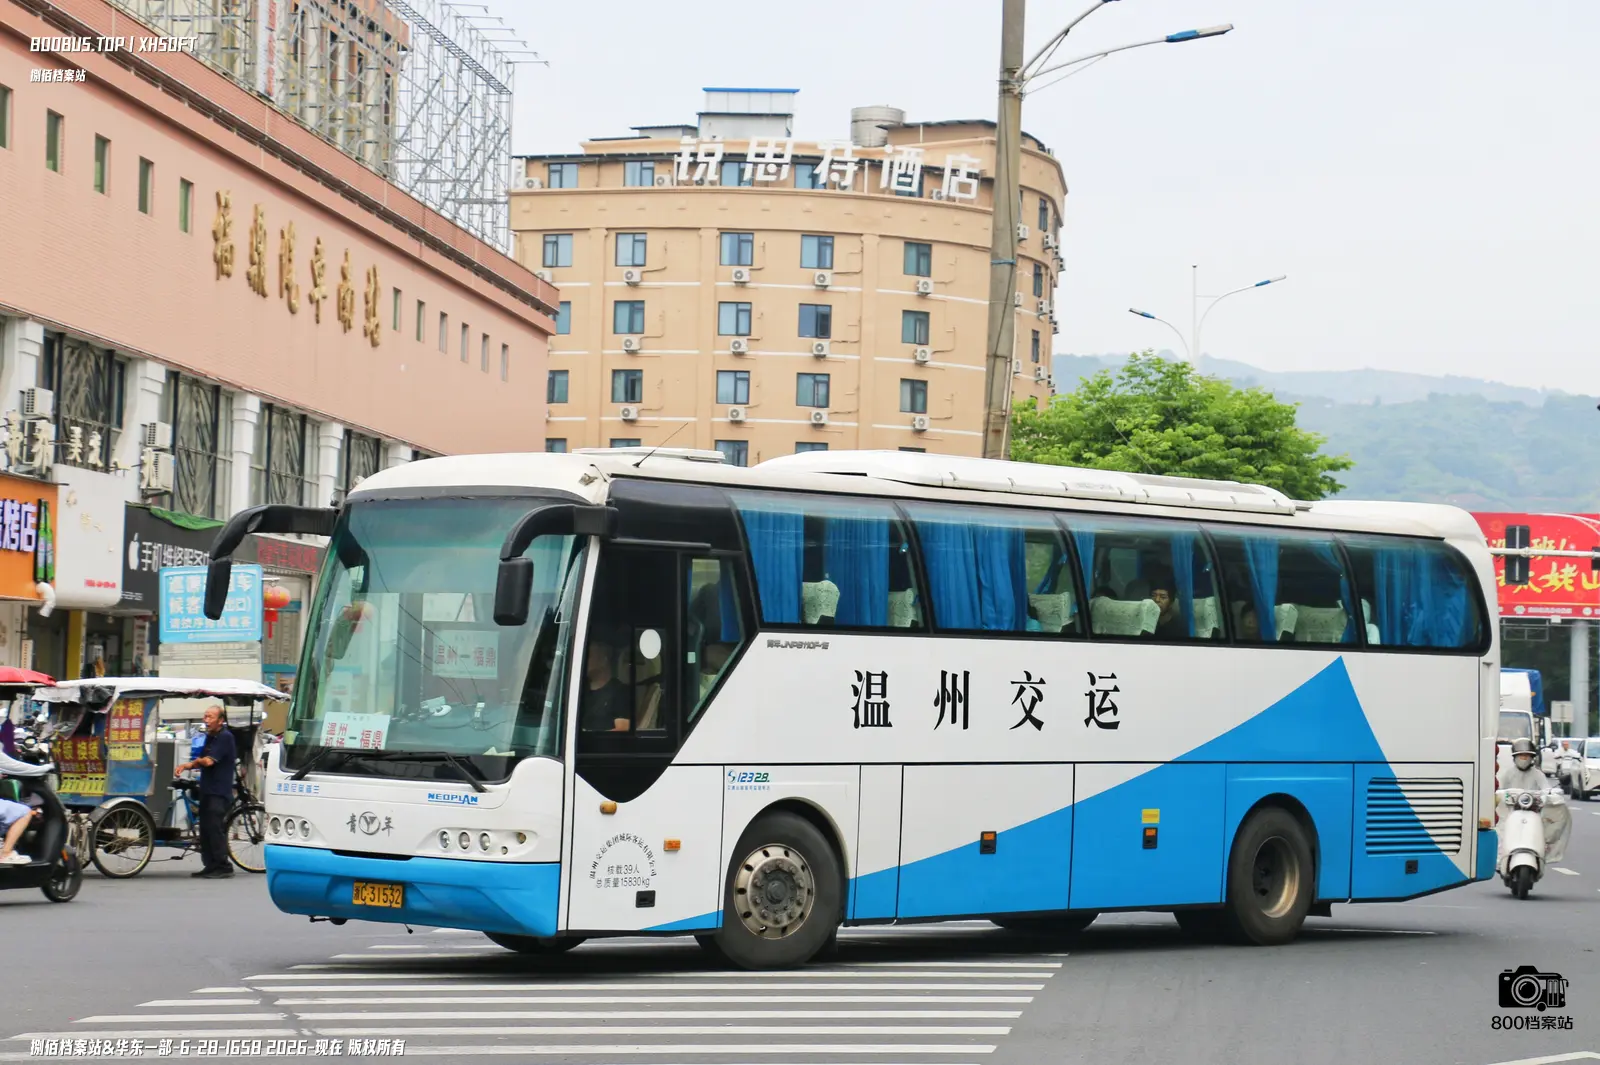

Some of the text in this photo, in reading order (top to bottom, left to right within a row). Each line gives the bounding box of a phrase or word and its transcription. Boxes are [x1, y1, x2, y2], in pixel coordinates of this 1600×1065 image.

[0, 499, 37, 552] 烤店
[850, 669, 1121, 732] 温州交运
[737, 772, 770, 783] 12328
[428, 792, 478, 805] NEOPLAN
